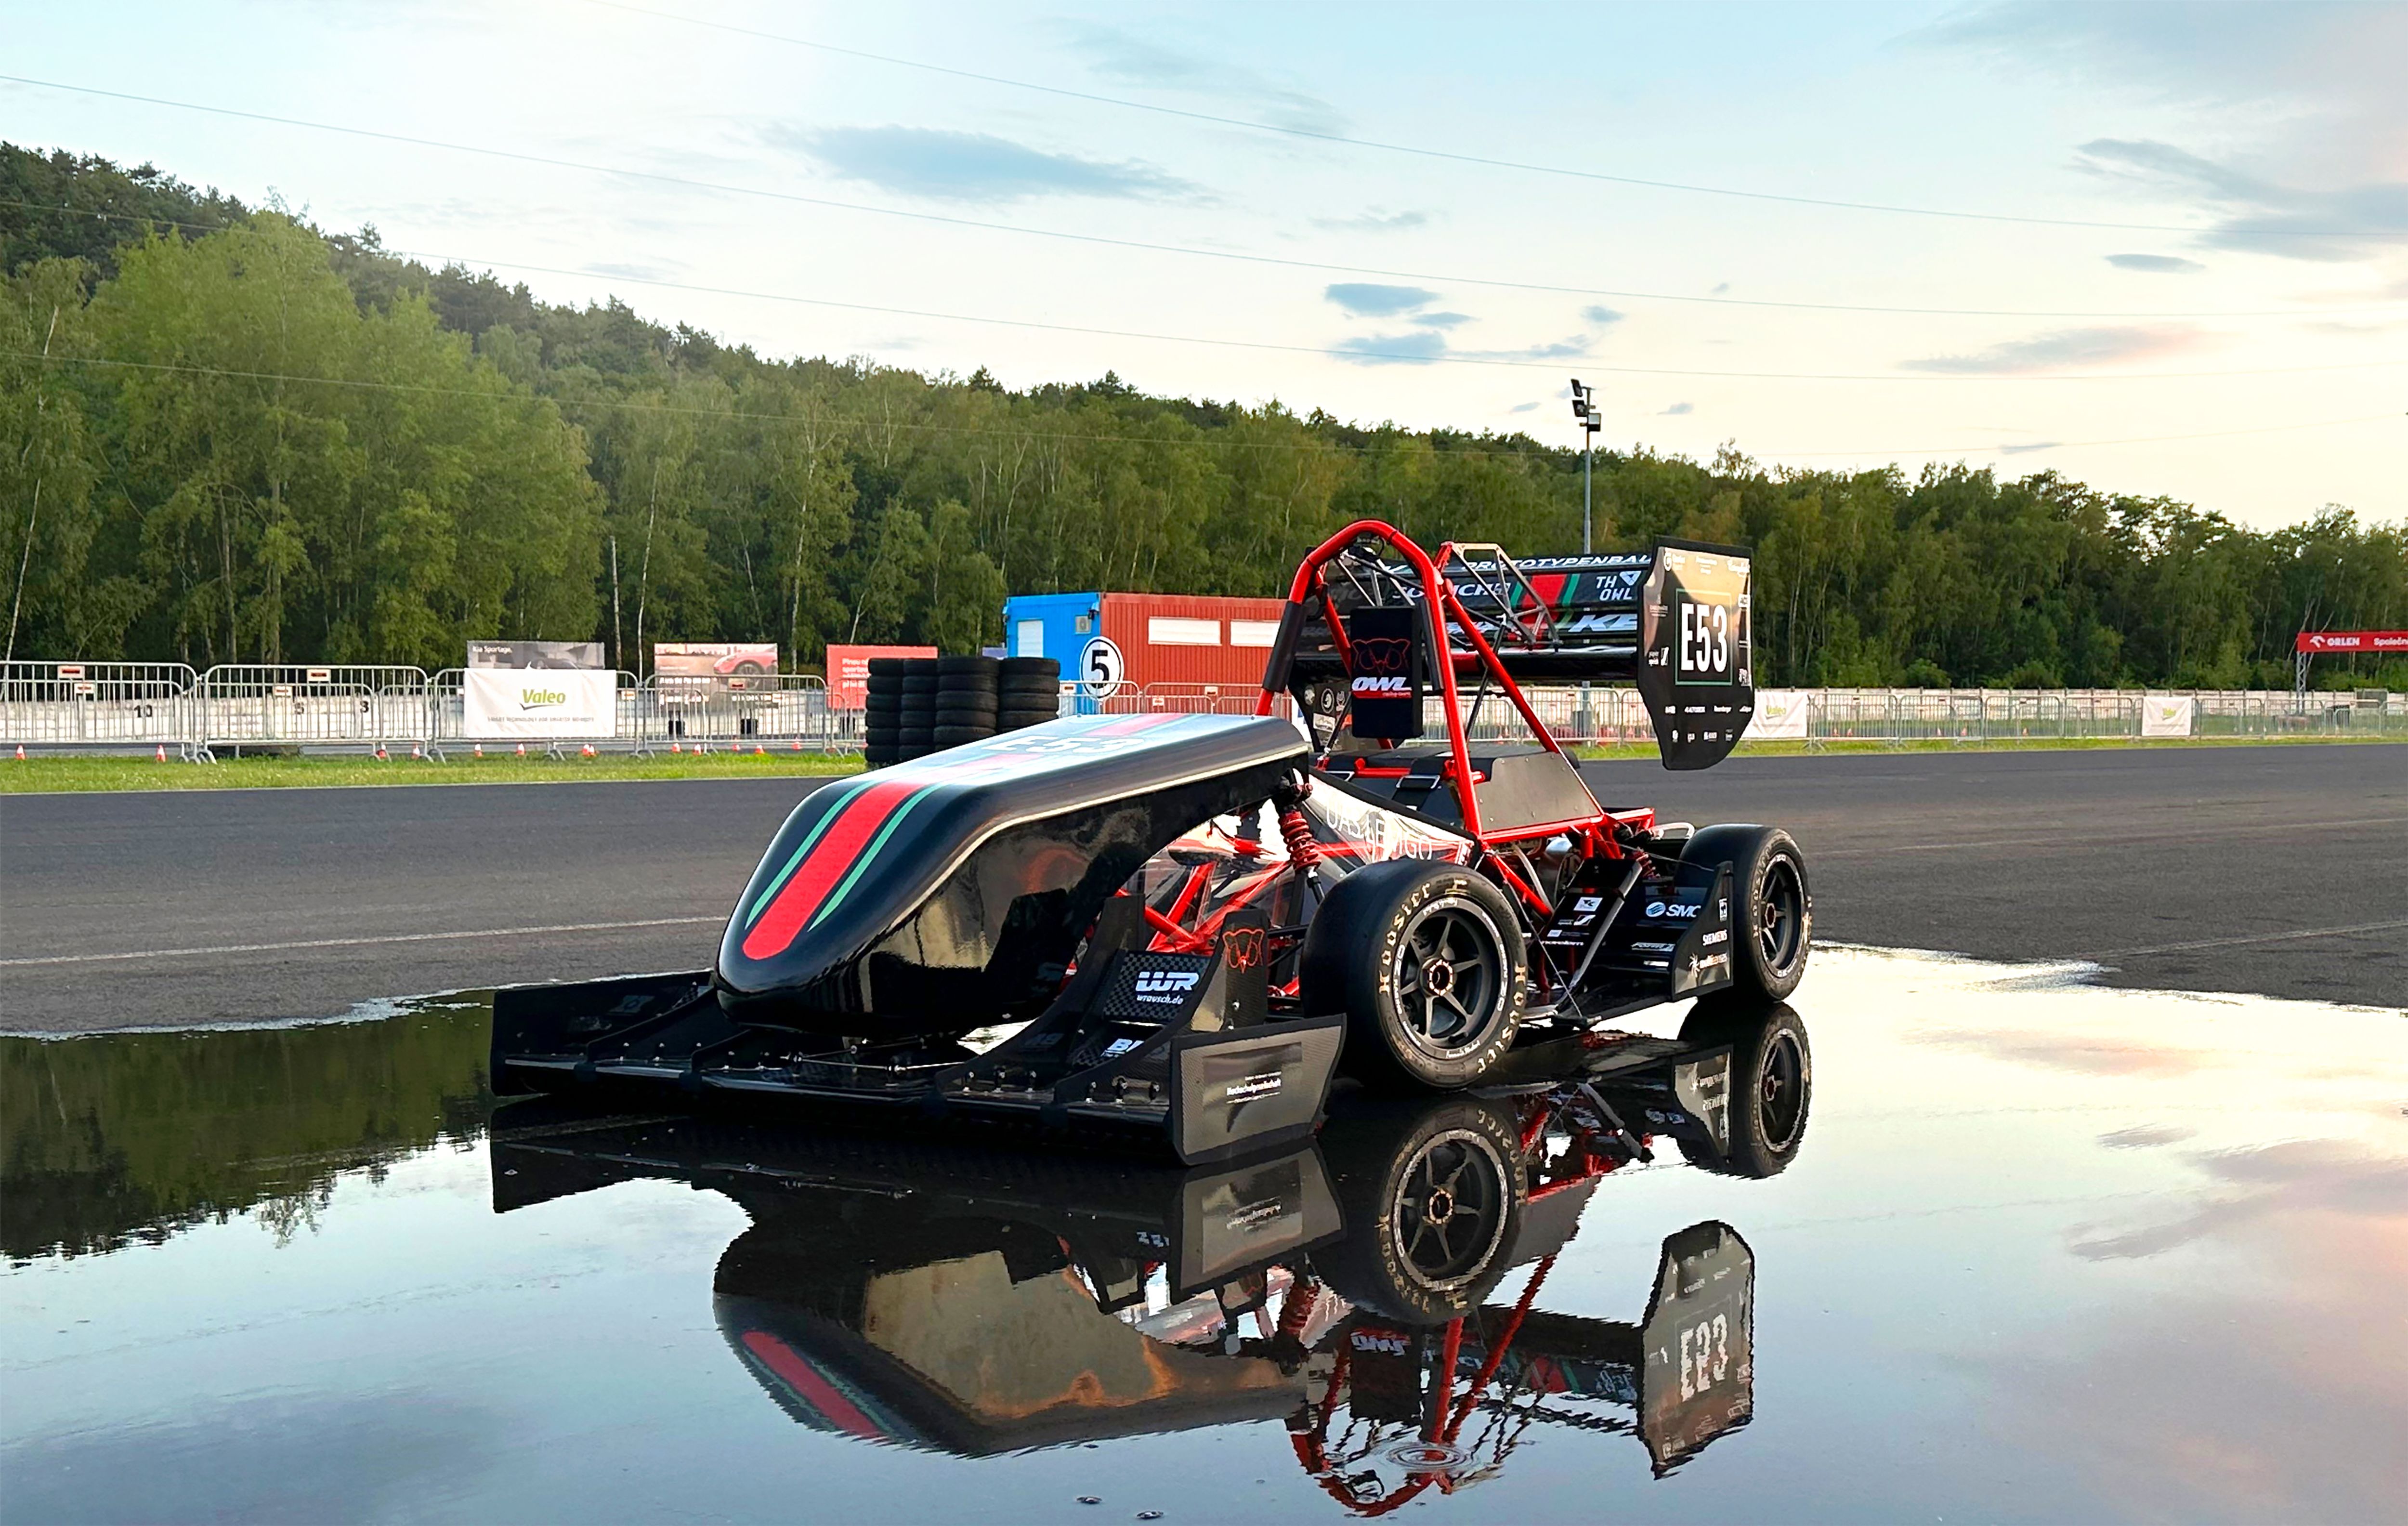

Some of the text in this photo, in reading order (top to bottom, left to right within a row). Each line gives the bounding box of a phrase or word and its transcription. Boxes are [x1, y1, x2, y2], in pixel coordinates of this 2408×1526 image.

[1596, 576, 1617, 588] TH
[1599, 588, 1632, 601] OWL
[1681, 603, 1728, 672] E53
[2327, 637, 2359, 646] ORLEN
[1091, 650, 1109, 688] 5
[1352, 677, 1412, 691] OWL
[523, 689, 566, 703] Valeo
[981, 735, 1145, 753] E53
[1666, 904, 1701, 917] SMC
[1379, 882, 1431, 998] Hoosier
[1137, 993, 1184, 1005] wrausch.de
[1477, 961, 1526, 1074] Hoosier
